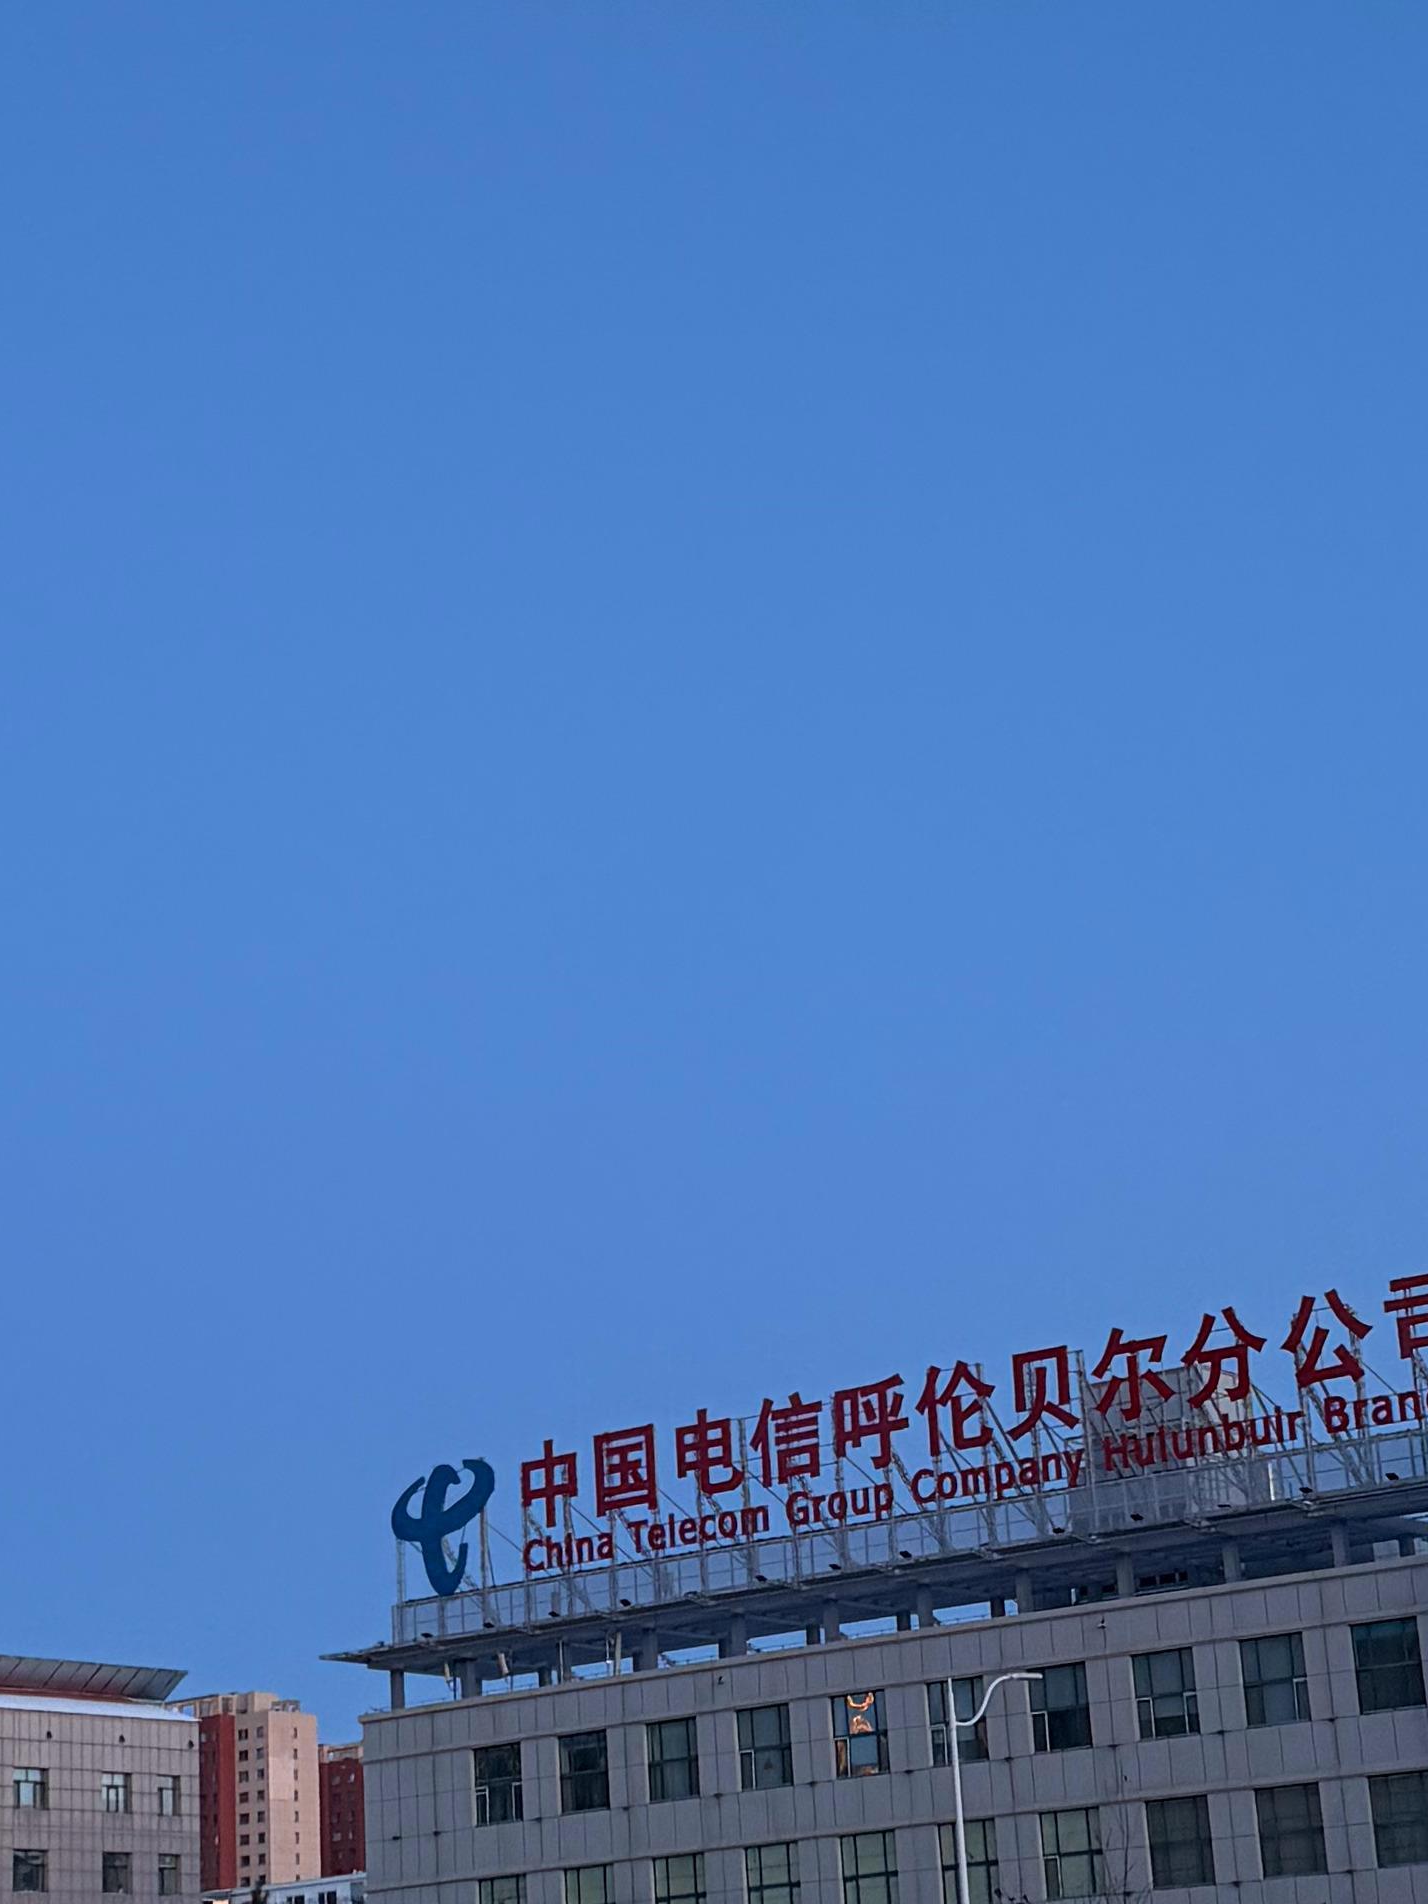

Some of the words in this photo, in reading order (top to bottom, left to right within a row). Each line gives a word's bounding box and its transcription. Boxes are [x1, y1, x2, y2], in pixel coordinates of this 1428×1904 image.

[523, 1531, 613, 1572] China
[628, 1505, 769, 1553] Telecom
[785, 1483, 894, 1528] Group
[911, 1448, 1086, 1504] Company
[1103, 1405, 1305, 1471] Hulunbuir
